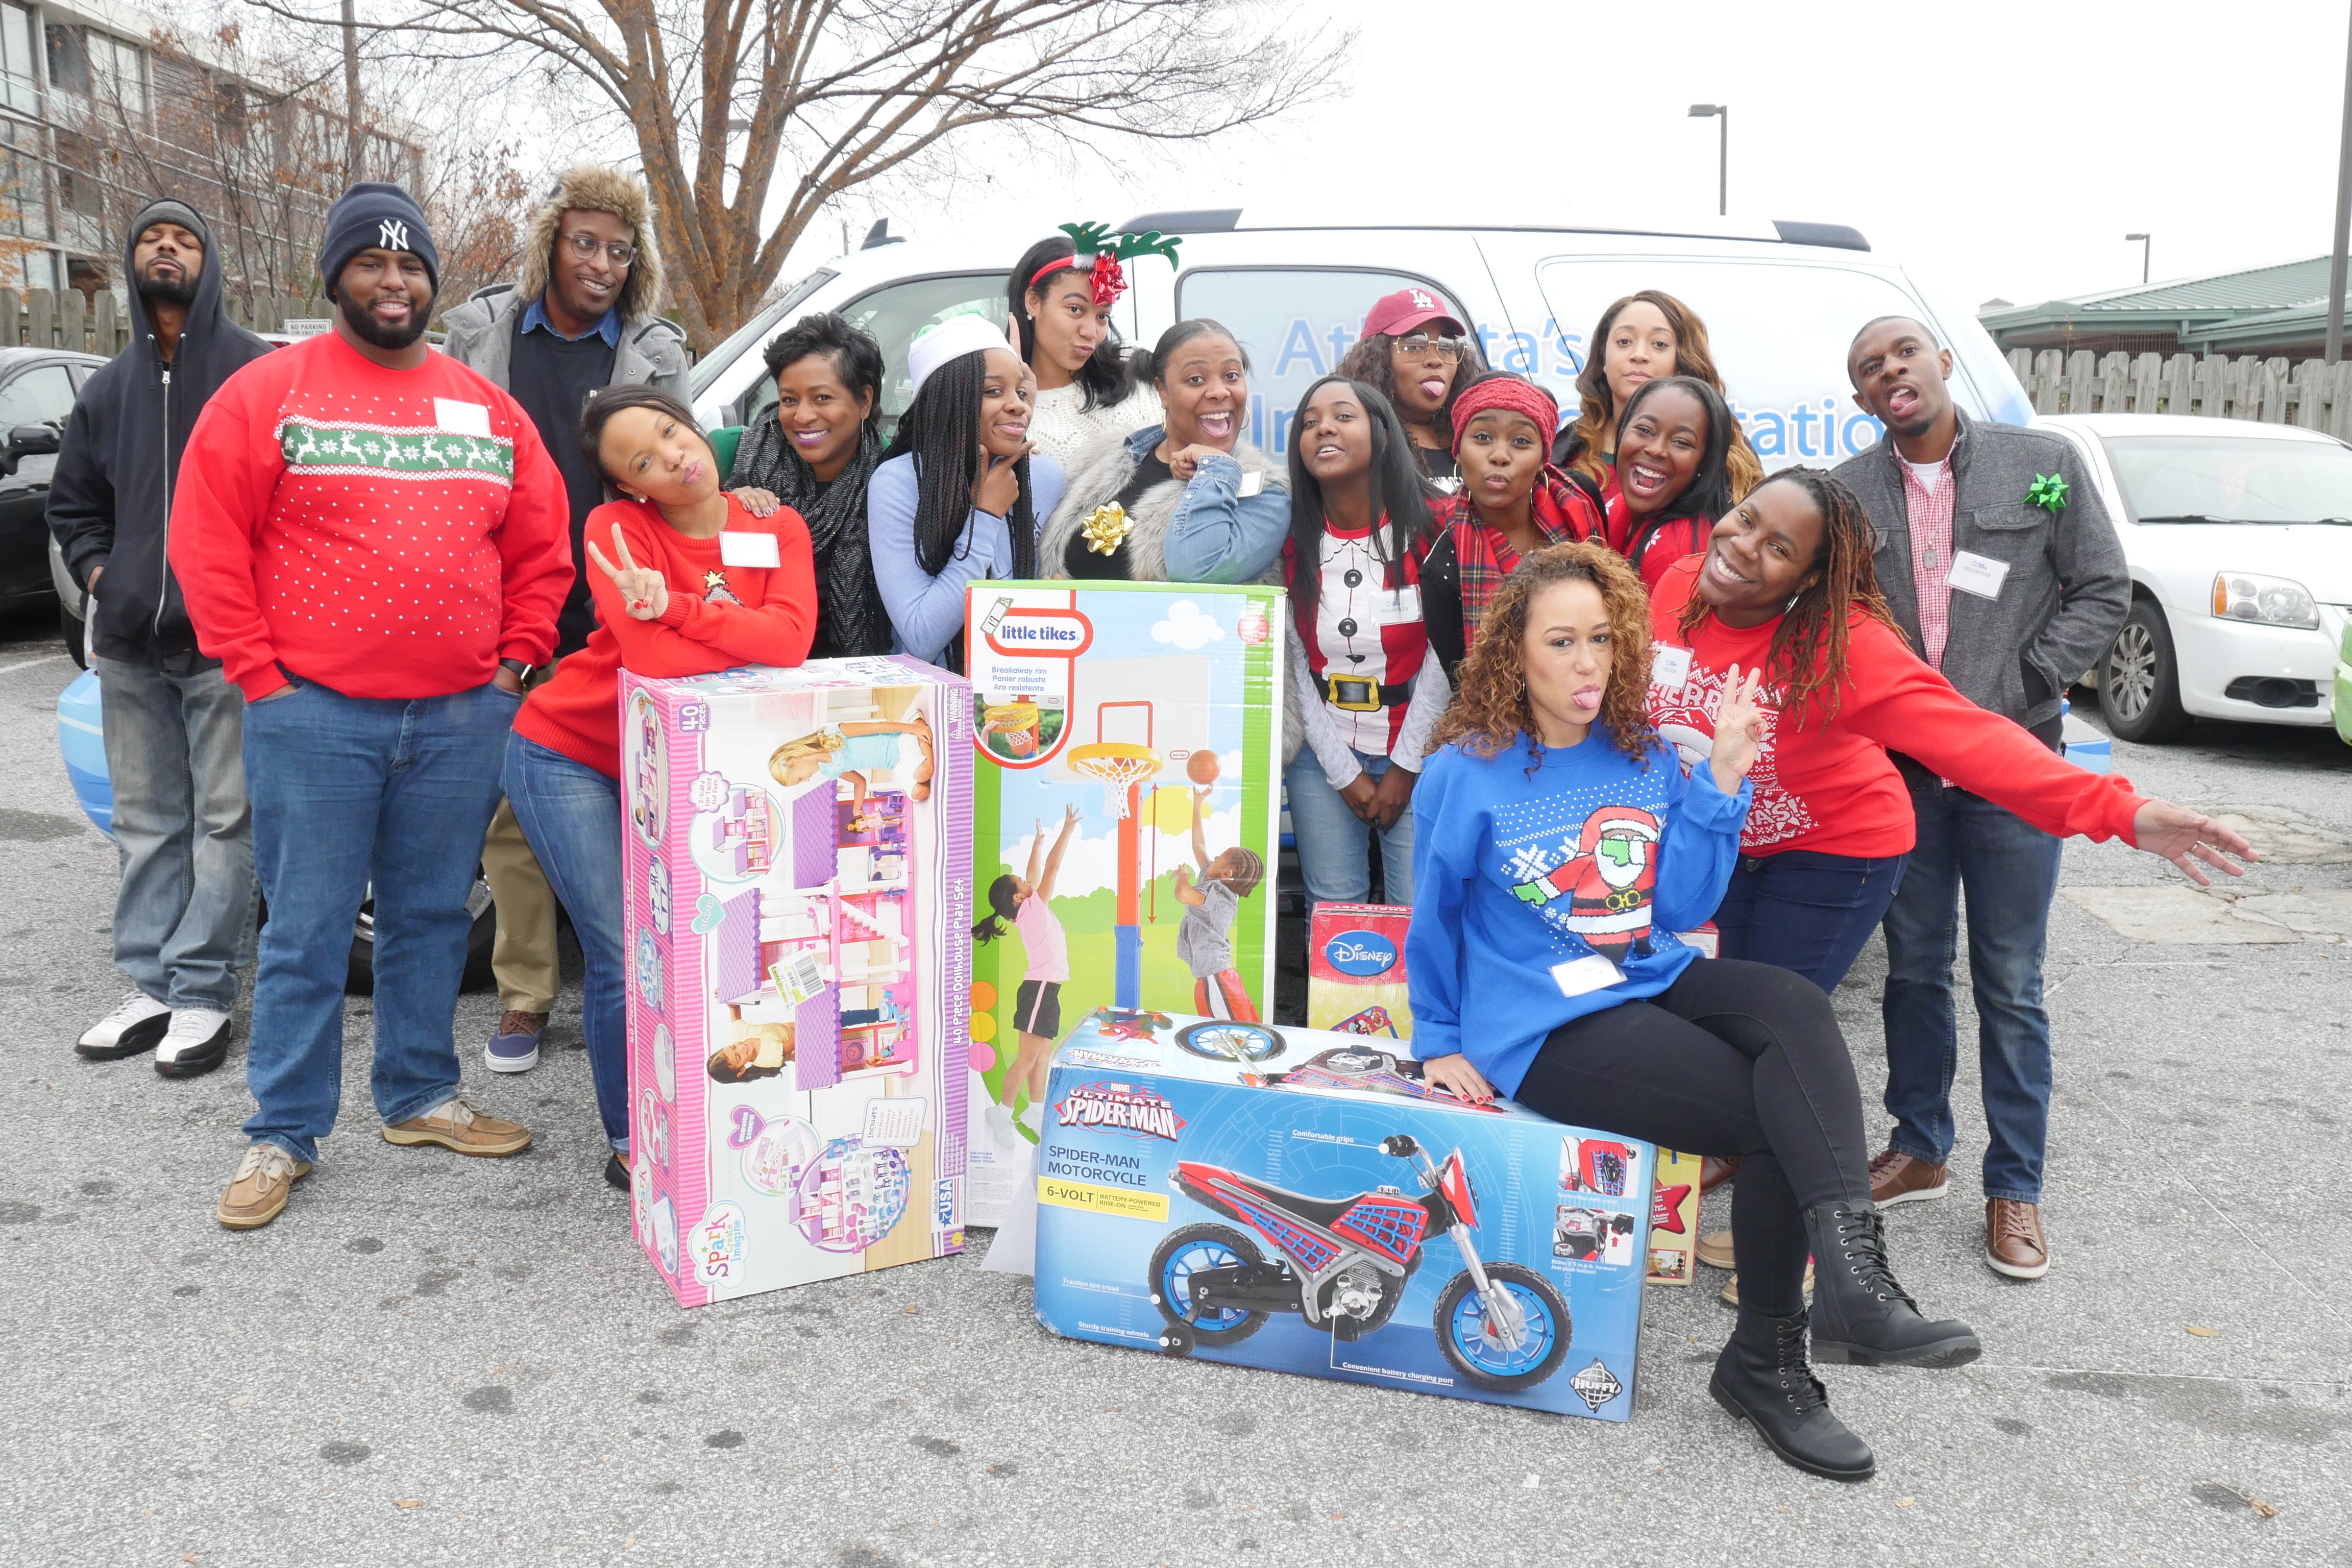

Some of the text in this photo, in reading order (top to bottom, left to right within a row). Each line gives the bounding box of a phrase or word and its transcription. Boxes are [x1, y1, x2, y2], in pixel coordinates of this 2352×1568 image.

[379, 219, 409, 251] NY
[1409, 289, 1435, 308] LA
[1963, 566, 1992, 578] VOLUNTEER
[1002, 625, 1076, 641] little tikes
[992, 667, 1033, 675] Breakaway
[949, 687, 958, 723] WARNING:
[681, 705, 699, 731] 40
[952, 877, 964, 1044] 40 Piece Dollhouse Play Set
[1330, 941, 1392, 968] Disney
[629, 1028, 634, 1043] 40
[1111, 1083, 1131, 1093] MARVEL
[1070, 1089, 1171, 1108] ULTIMATE
[1059, 1097, 1178, 1141] SPIDER-MAN
[1292, 1130, 1335, 1140] Comfortable
[1048, 1145, 1140, 1169] SPIDER-MAN
[1048, 1161, 1146, 1186] MOTORCYCLE
[639, 1170, 648, 1231] Spark
[939, 1179, 952, 1213] USA
[1047, 1186, 1094, 1203] 6-VOLT
[1100, 1194, 1161, 1207] BATTERY-POWERED
[1557, 1192, 1588, 1200] Spider-Man
[1099, 1200, 1126, 1209] RIDE-ON
[705, 1212, 729, 1277] Spark
[725, 1224, 733, 1253] Create
[731, 1220, 744, 1262] Imagine
[1062, 1278, 1088, 1287] Traction
[1078, 1321, 1149, 1338] Sturdy training wheels
[1342, 1362, 1380, 1373] Convenient
[1382, 1368, 1406, 1378] battery
[1408, 1372, 1437, 1383] charging
[1574, 1377, 1618, 1393] HUFFY
